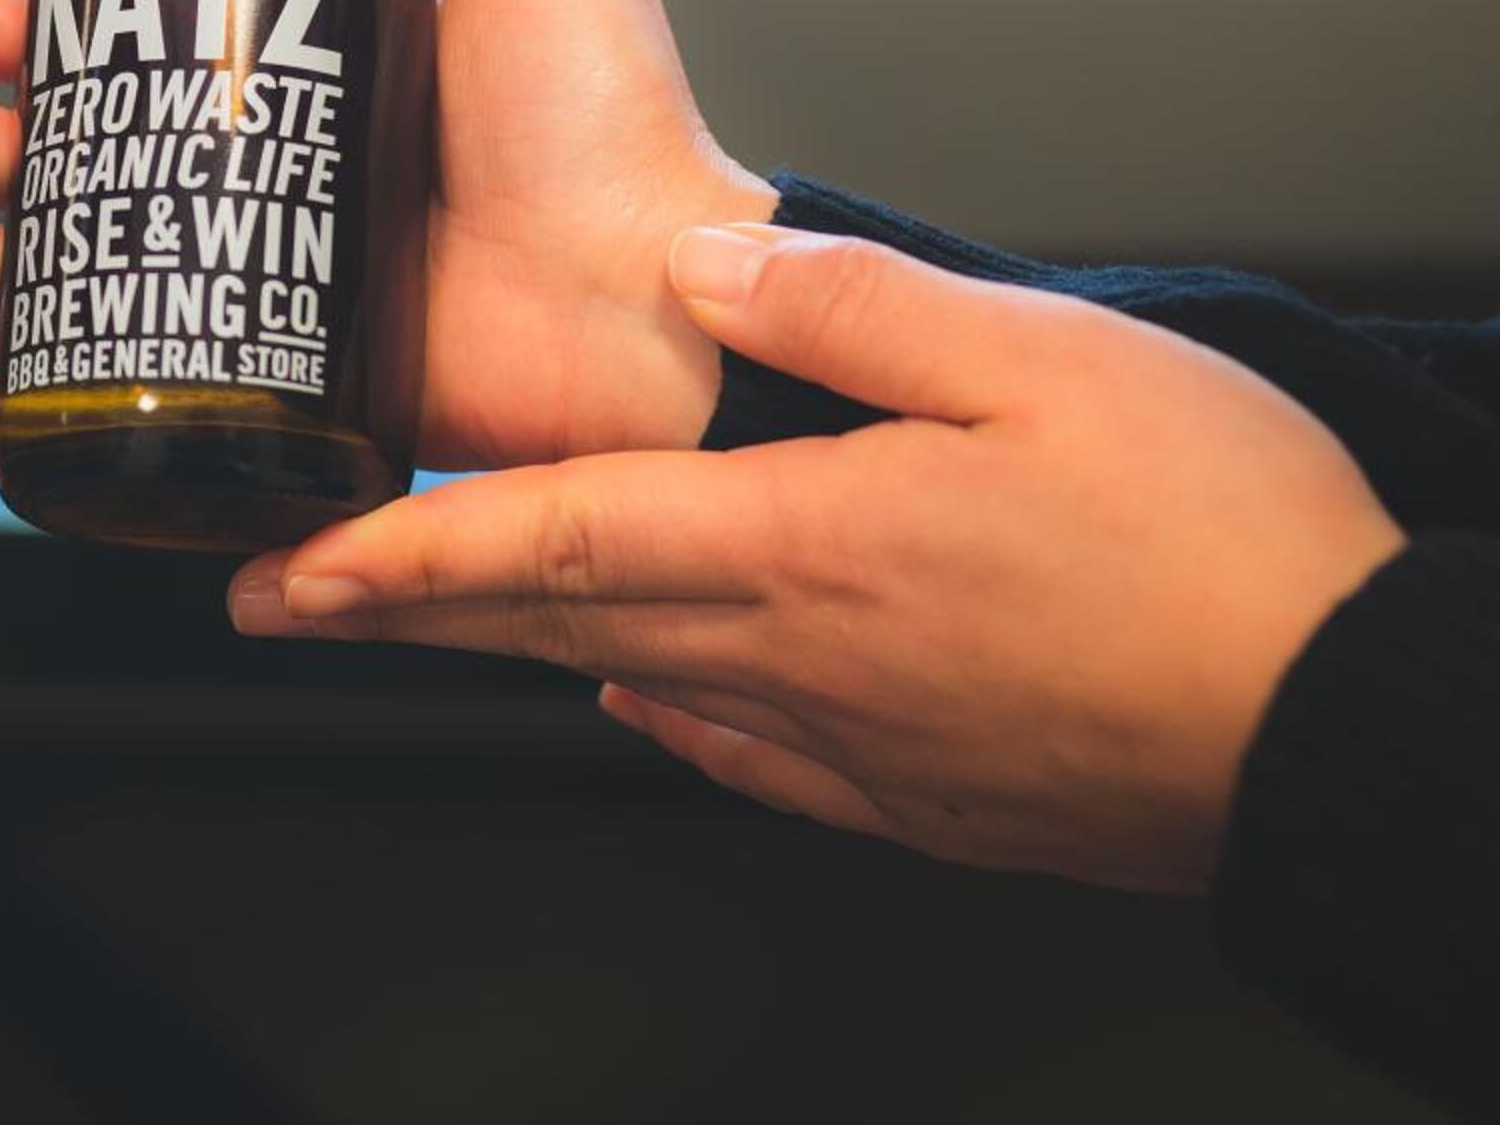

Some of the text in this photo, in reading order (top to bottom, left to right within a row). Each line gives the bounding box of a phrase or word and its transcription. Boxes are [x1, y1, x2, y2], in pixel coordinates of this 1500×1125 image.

[26, 69, 344, 155] ZERO WASTE
[22, 134, 341, 210] ORGANIC LIFE
[16, 195, 334, 287] RISE & WIN
[11, 272, 327, 351] BREWING CO.
[7, 350, 49, 395] BBQ
[72, 338, 231, 383] GENERAL
[238, 344, 325, 387] STORE
